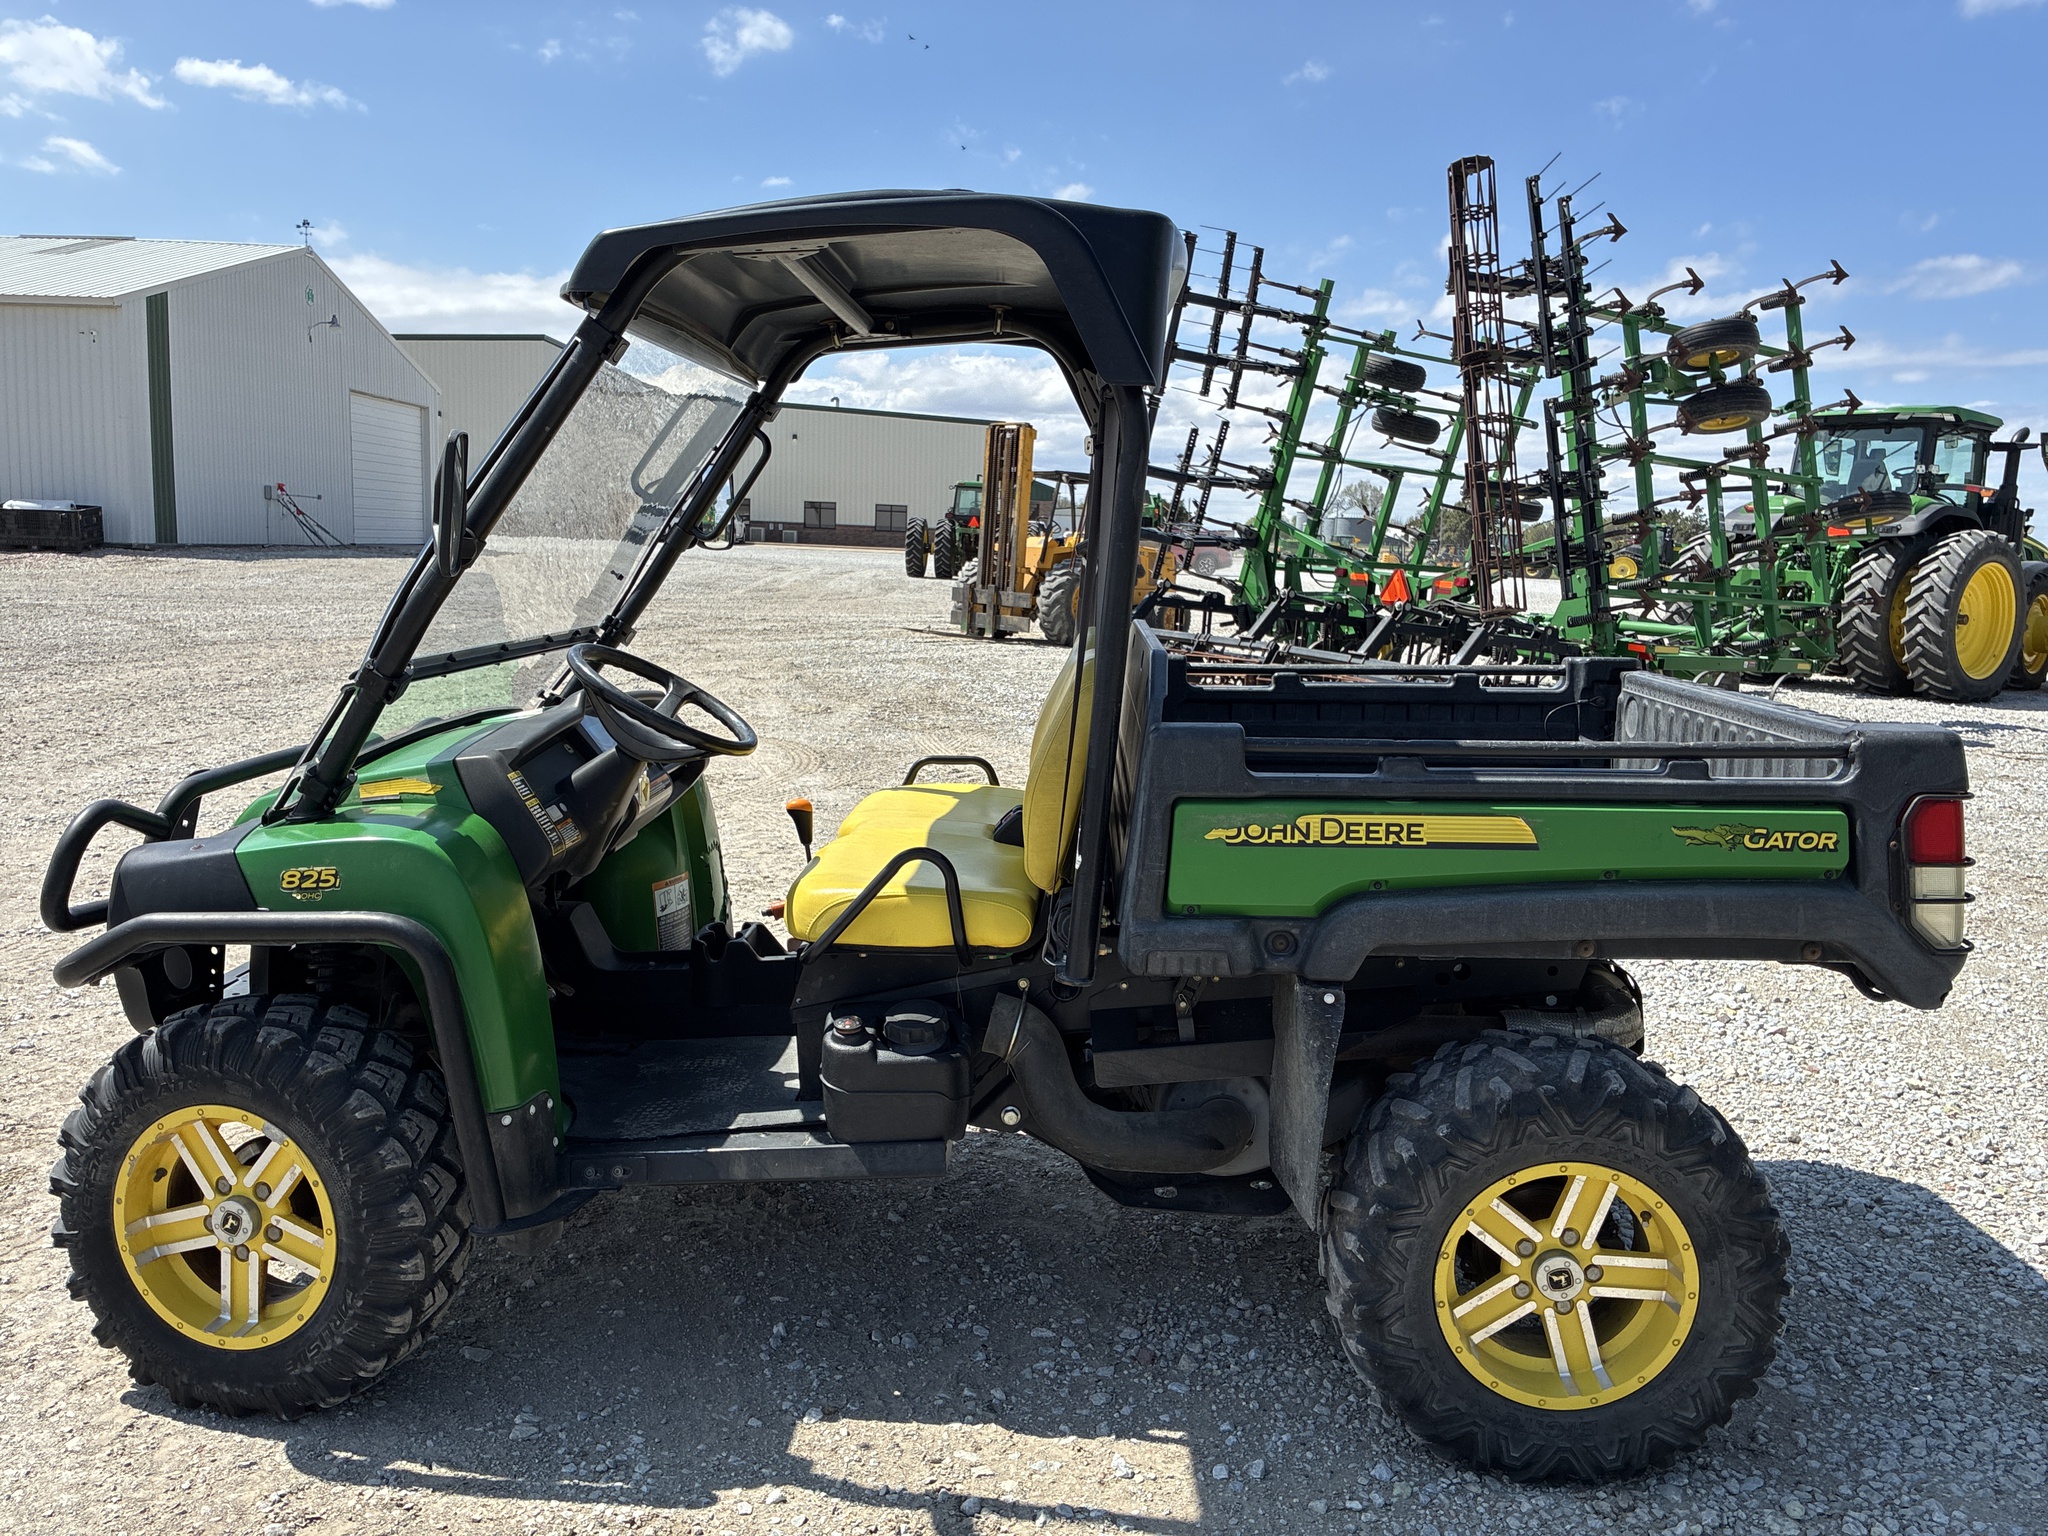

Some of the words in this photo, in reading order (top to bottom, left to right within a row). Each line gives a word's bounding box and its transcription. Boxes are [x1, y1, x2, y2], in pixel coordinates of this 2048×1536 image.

[1225, 821, 1311, 842] JOHN
[1319, 817, 1425, 843] DEERE
[1743, 827, 1839, 851] GATOR
[279, 1283, 360, 1376] CARLISLE
